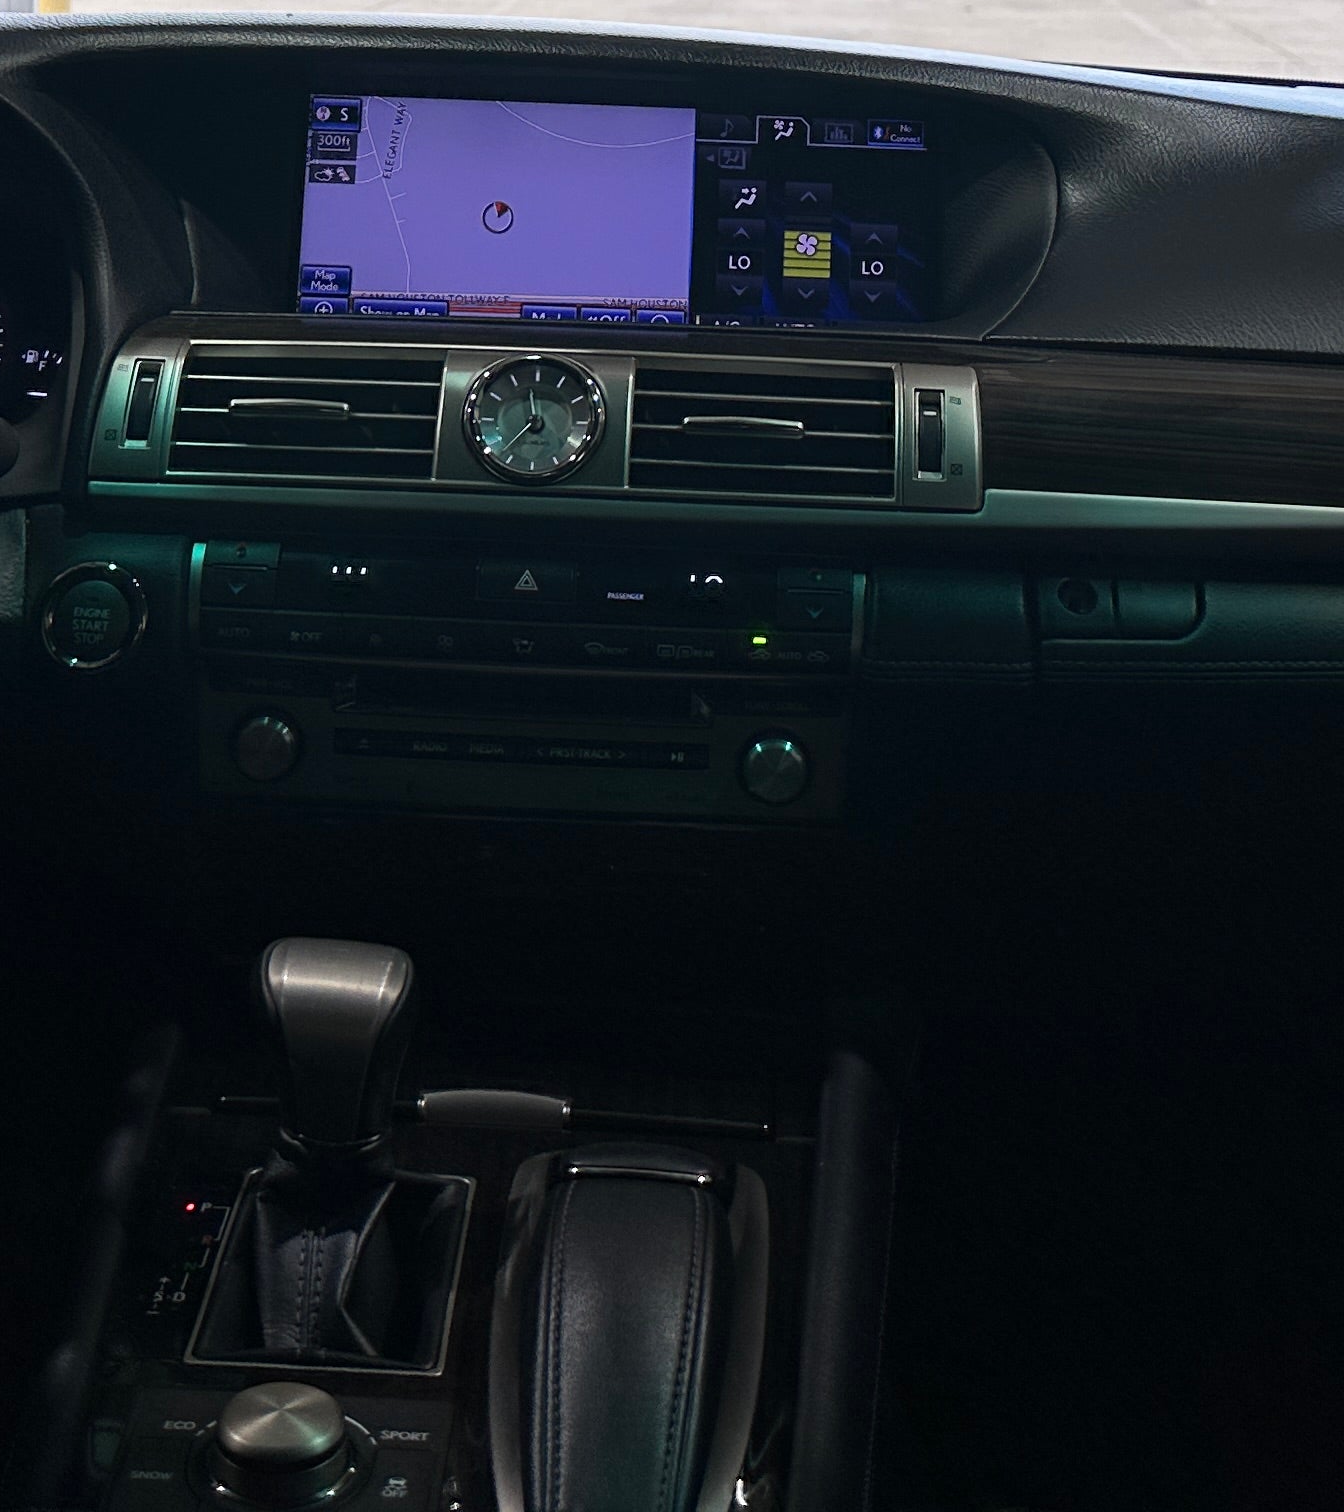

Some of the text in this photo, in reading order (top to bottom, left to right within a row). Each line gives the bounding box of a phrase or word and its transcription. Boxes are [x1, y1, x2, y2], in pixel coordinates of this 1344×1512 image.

[339, 107, 349, 122] S
[317, 134, 351, 146] 300ft
[383, 101, 407, 179] ELEGANT WAY
[728, 255, 752, 270] LO
[860, 261, 885, 276] LO
[315, 269, 337, 282] Map
[310, 280, 339, 292] Mode
[38, 361, 48, 372] F
[607, 591, 645, 601] PASSENGER
[73, 607, 111, 618] ENGINE
[73, 619, 109, 632] START
[73, 631, 104, 645] STOP
[200, 1202, 213, 1212] P
[171, 1291, 187, 1303] D
[163, 1420, 197, 1431] ECO
[380, 1429, 431, 1442] SPORT
[130, 1469, 175, 1480] SNOW
